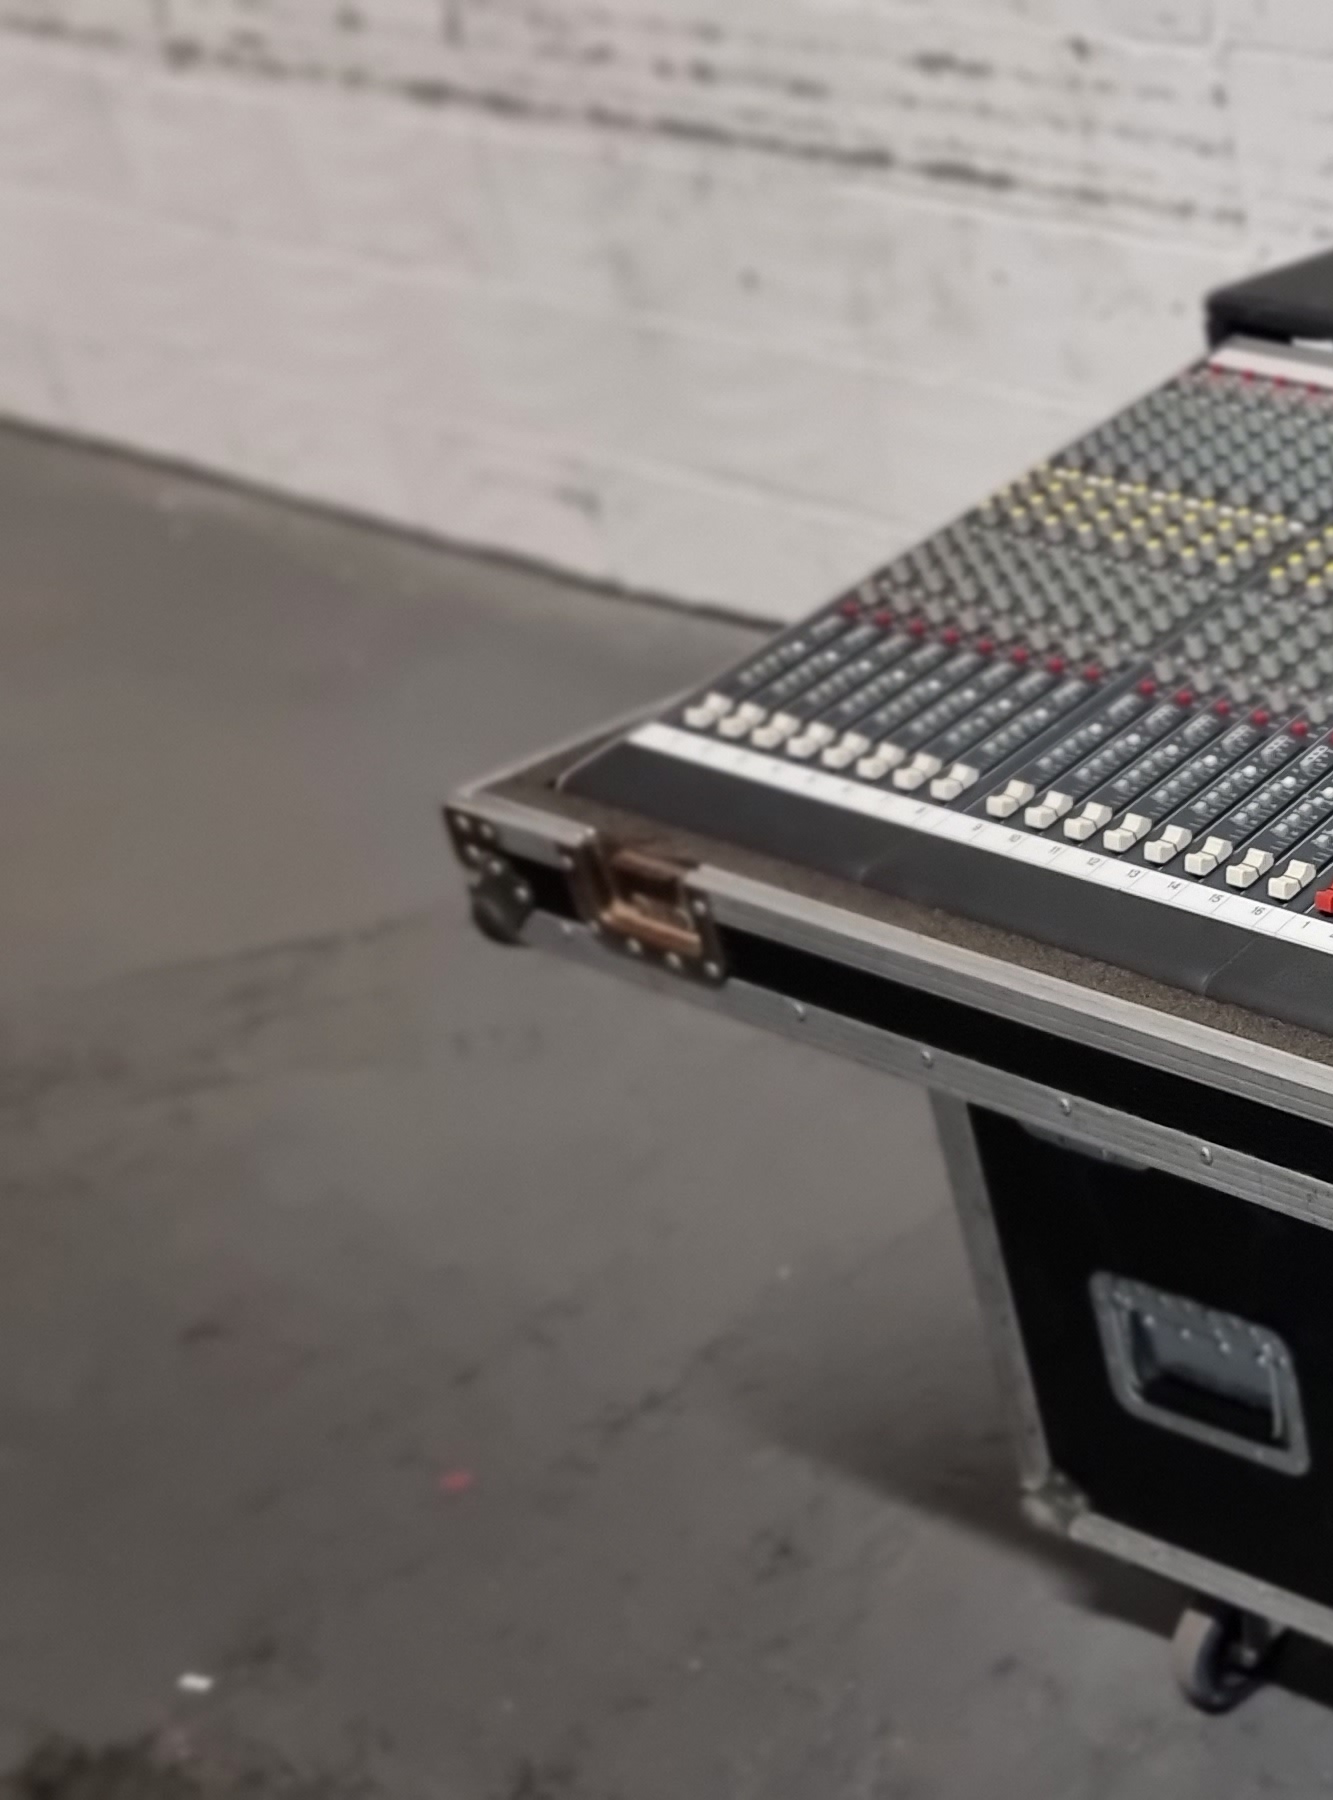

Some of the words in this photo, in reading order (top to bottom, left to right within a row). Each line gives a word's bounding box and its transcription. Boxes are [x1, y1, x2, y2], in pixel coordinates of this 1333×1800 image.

[1086, 856, 1101, 867] 12
[1127, 868, 1141, 879] 13
[1167, 881, 1182, 890] 14
[1208, 893, 1224, 903] 15
[1251, 906, 1266, 916] 16
[1302, 920, 1311, 929] 1
